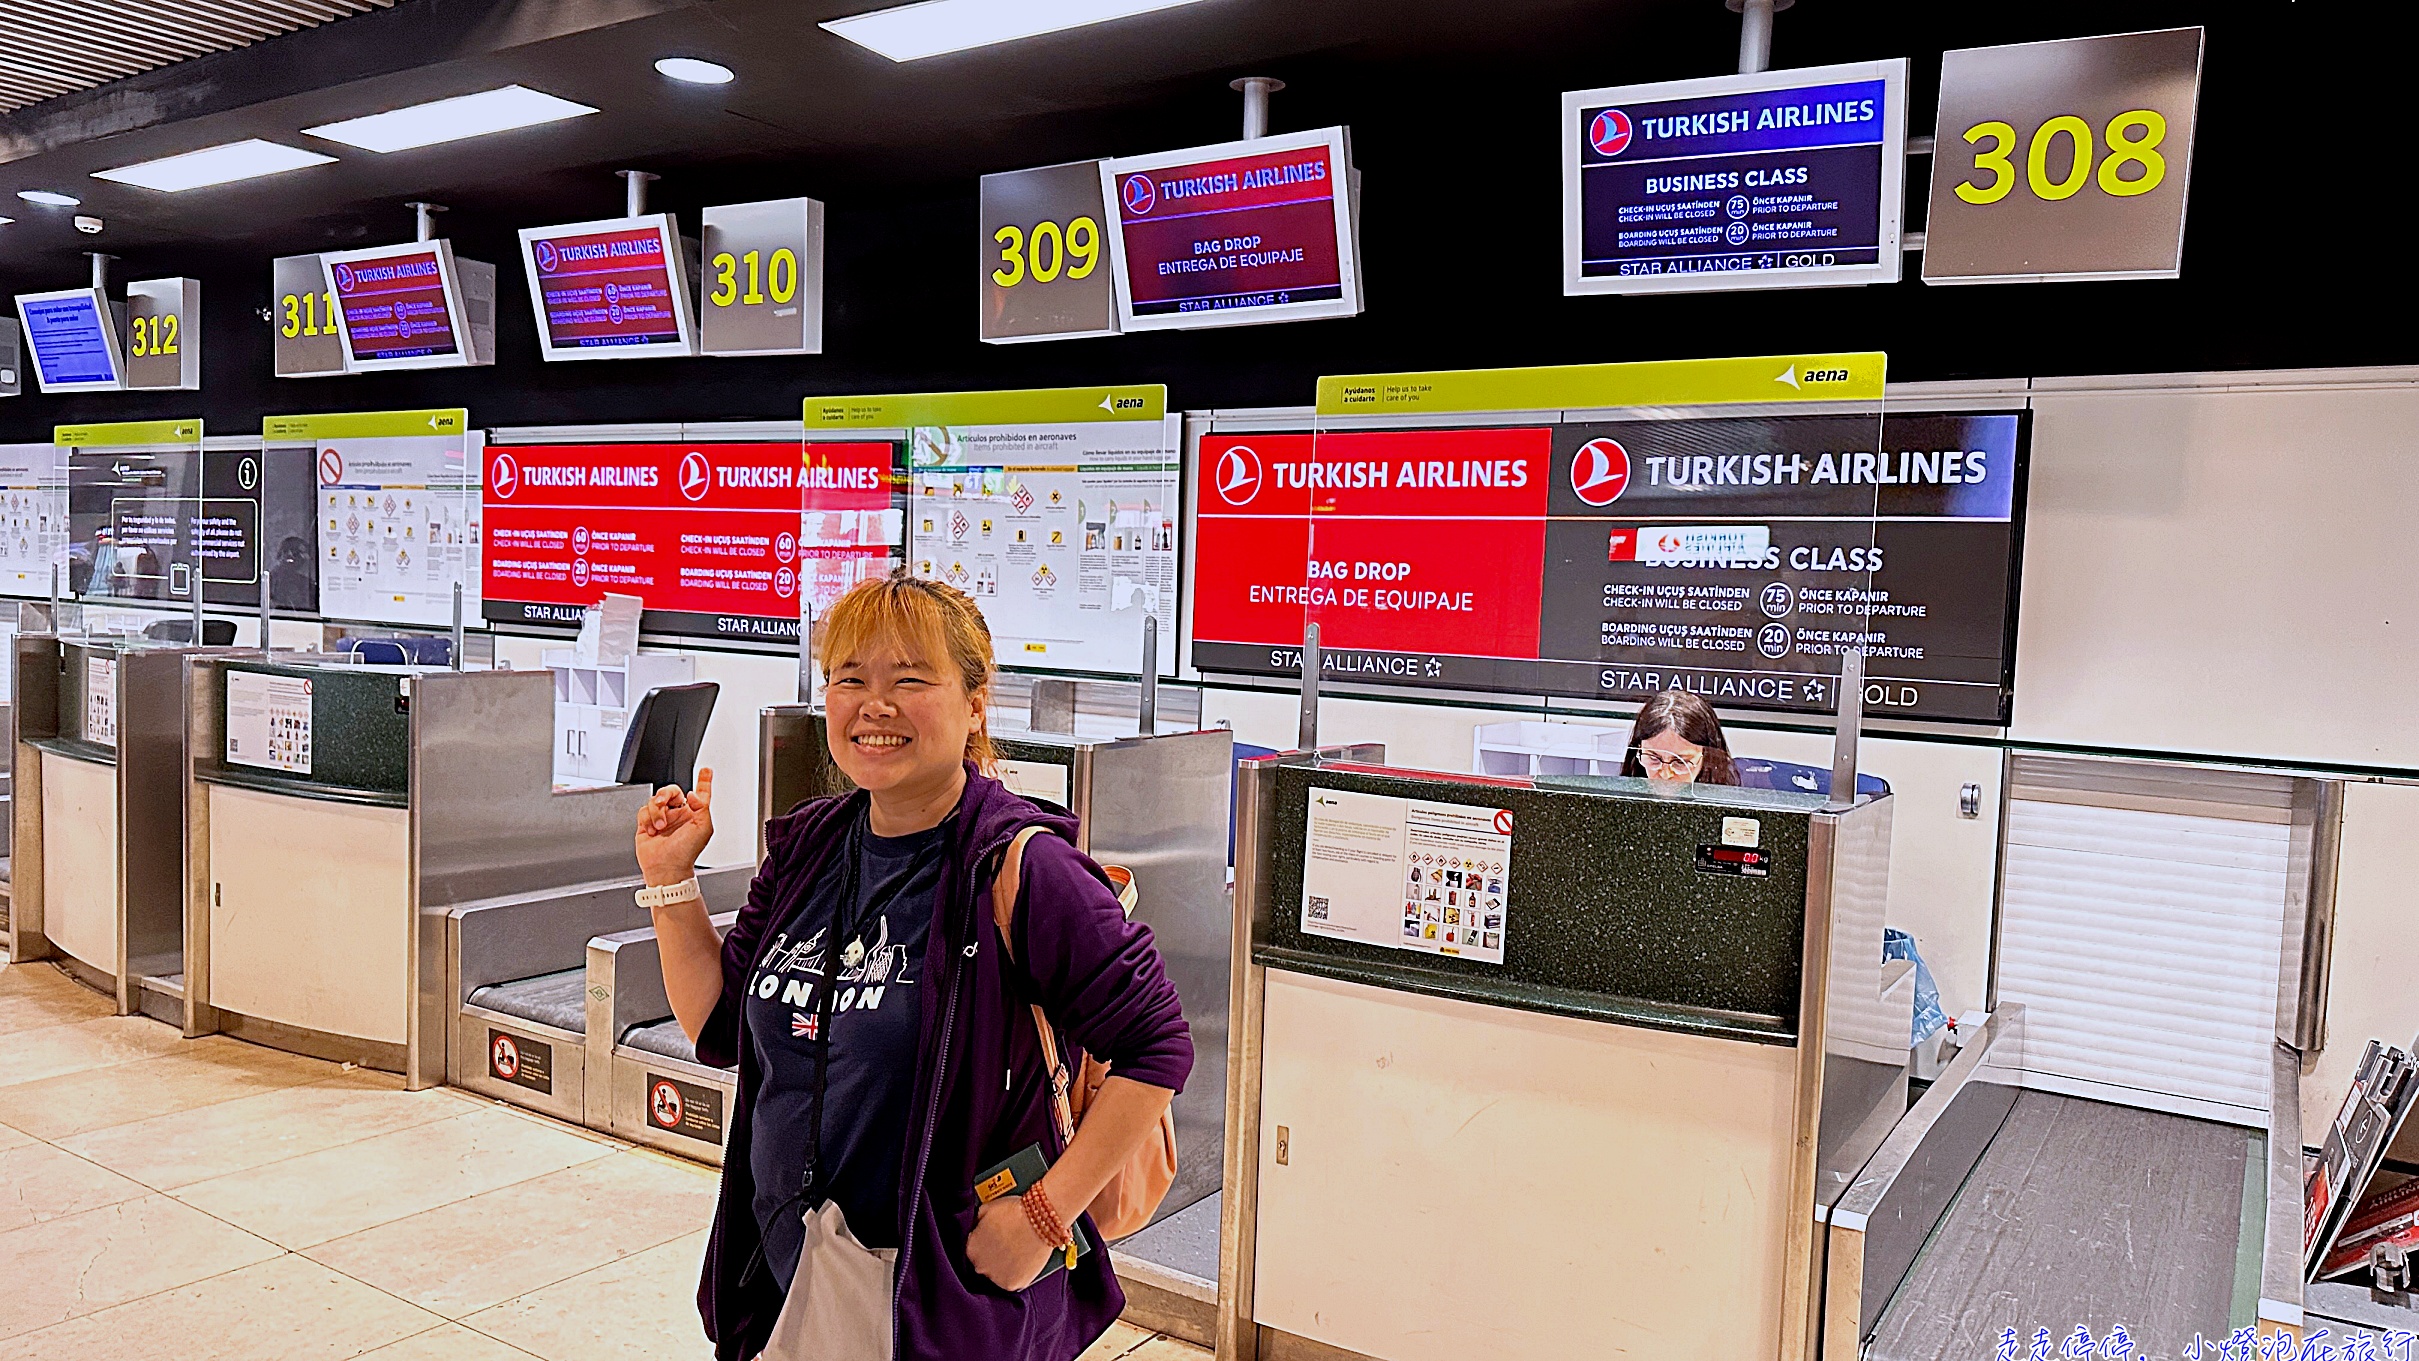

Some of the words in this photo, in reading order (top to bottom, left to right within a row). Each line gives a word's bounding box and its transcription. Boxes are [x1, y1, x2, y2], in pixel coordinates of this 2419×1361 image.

[1642, 110, 1749, 139] TURKISH
[1757, 100, 1874, 130] AIRLINES
[1954, 109, 2166, 205] 308
[1161, 173, 1238, 200] TURKISH
[1243, 161, 1326, 189] AIRLINES
[1646, 172, 1739, 194] BUSINESS
[1745, 167, 1808, 187] CLASS
[1731, 200, 1744, 209] 75
[1753, 197, 1775, 205] ÖNCE
[1777, 195, 1812, 204] KAPANIR
[1619, 205, 1654, 214] CHECK-IN
[1753, 205, 1777, 214] PRIOR
[1779, 205, 1789, 213] TO
[1791, 202, 1838, 211] DEPARTURE
[1619, 214, 1653, 223] CHECK-IN
[1685, 210, 1715, 218] CLOSED
[1730, 226, 1744, 235] 20
[1752, 223, 1775, 232] ÖNCE
[1777, 222, 1812, 230] KAPANIR
[1752, 232, 1776, 240] PRIOR
[1790, 228, 1837, 238] DEPARTURE
[1619, 231, 1657, 240] BOARDING
[1619, 239, 1657, 248] BOARDING
[1689, 236, 1718, 244] CLOSED
[559, 244, 608, 262] TURKISH
[610, 239, 661, 257] AIRLINES
[992, 216, 1099, 288] 309
[1194, 240, 1221, 255] BAG
[1225, 236, 1262, 252] DROP
[1158, 257, 1217, 276] ENTREGA
[1220, 255, 1238, 269] DE
[1240, 248, 1304, 268] EQUIPAJE
[1620, 262, 1661, 276] STAR
[1667, 257, 1751, 274] ALLIANCE
[1786, 254, 1835, 268] GOLD
[354, 266, 395, 283] TURKISH
[397, 261, 438, 278] AIRLINES
[710, 248, 797, 307] 310
[1179, 299, 1210, 312] STAR
[1213, 295, 1274, 310] ALLIANCE
[282, 291, 337, 338] 311
[132, 314, 178, 357] 312
[1804, 368, 1848, 383] aena
[1344, 386, 1375, 396] Ayúdanos
[1387, 385, 1401, 394] Help
[1418, 384, 1432, 392] take
[1116, 397, 1143, 410] aena
[1407, 395, 1420, 403] you
[438, 418, 453, 426] aena
[989, 433, 1026, 443] prohibidos
[986, 442, 1025, 451] prohibited
[1026, 442, 1033, 450] in
[1034, 442, 1058, 450] aircraft
[1273, 462, 1388, 489] TURKISH
[1396, 460, 1528, 488] AIRLINES
[1645, 453, 1801, 487] TURKISH
[1811, 451, 1987, 484] AIRLINES
[523, 466, 586, 486] TURKISH
[589, 466, 658, 487] AIRLINES
[716, 466, 792, 488] TURKISH
[797, 467, 879, 489] AIRLINES
[575, 532, 586, 542] 60
[609, 533, 636, 541] KAPANIR
[779, 538, 791, 549] 60
[739, 548, 765, 557] CLOSED
[1790, 547, 1883, 572] CLASS
[575, 564, 586, 574] 20
[609, 565, 635, 573] KAPANIR
[1308, 560, 1349, 580] BAG
[1354, 562, 1411, 581] DROP
[779, 572, 790, 584] 20
[741, 581, 768, 591] CLOSED
[1604, 585, 1655, 596] CHECK-IN
[1657, 586, 1685, 598] UÇUŞ
[1688, 586, 1750, 599] SAATİNDEN
[1249, 585, 1337, 606] ENTREGA
[1343, 589, 1368, 607] DE
[1374, 589, 1473, 612] EQUIPAJE
[1766, 589, 1785, 603] 75
[1799, 588, 1833, 601] ÖNCE
[1835, 590, 1888, 602] KAPANIR
[1603, 597, 1654, 608] CHECK-IN
[1655, 599, 1683, 609] WILL
[1684, 600, 1697, 609] BE
[1699, 600, 1742, 611] CLOSED
[1766, 603, 1786, 612] min
[1798, 602, 1833, 614] PRIOR
[1836, 604, 1853, 614] TO
[1856, 604, 1926, 617] DEPARTURE
[525, 605, 550, 619] STAR
[553, 607, 585, 620] ALLIA
[718, 618, 749, 633] STAR
[752, 619, 801, 635] ALLIANC
[1602, 623, 1657, 634] BOARDING
[1659, 624, 1687, 636] UÇUŞ
[1690, 625, 1752, 638] SAATİNDEN
[1764, 629, 1783, 643] 20
[1797, 627, 1830, 642] ÖNCE
[1832, 630, 1886, 643] KAPANIR
[1601, 635, 1656, 647] BOARDING
[1657, 637, 1684, 648] WILL
[1686, 638, 1700, 649] BE
[1702, 639, 1745, 651] CLOSED
[1763, 643, 1783, 652] min
[1795, 643, 1831, 655] PRIOR
[1833, 644, 1850, 655] TO
[1270, 650, 1303, 668] STA
[1323, 654, 1418, 675] ALLIANCE
[1601, 671, 1661, 690] STAR
[1668, 674, 1794, 700] ALLIANCE
[1864, 685, 1918, 707] OLD
